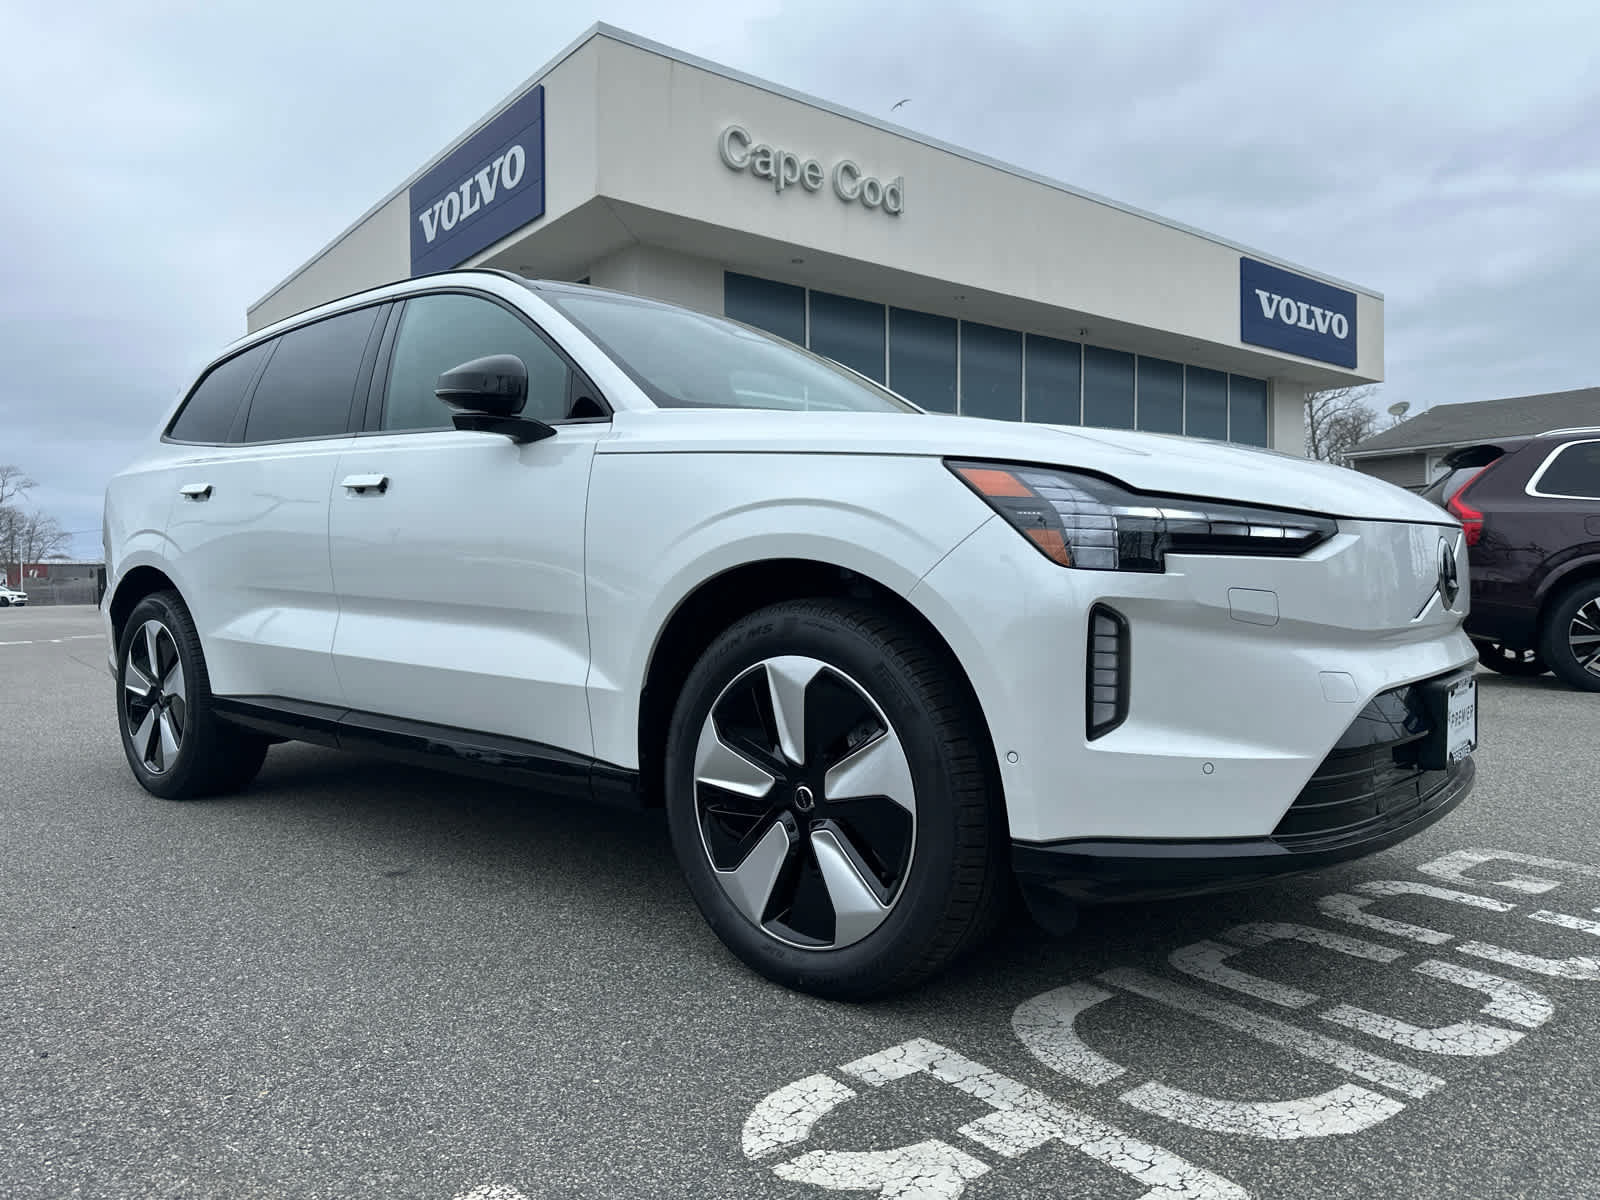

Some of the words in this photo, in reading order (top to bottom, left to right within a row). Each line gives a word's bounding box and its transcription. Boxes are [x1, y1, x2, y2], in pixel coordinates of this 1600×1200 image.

[418, 144, 526, 243] VOLVO
[719, 125, 825, 193] Cape
[832, 159, 905, 216] Cod
[1255, 288, 1349, 340] VOLVO
[1451, 704, 1473, 727] PREMIER
